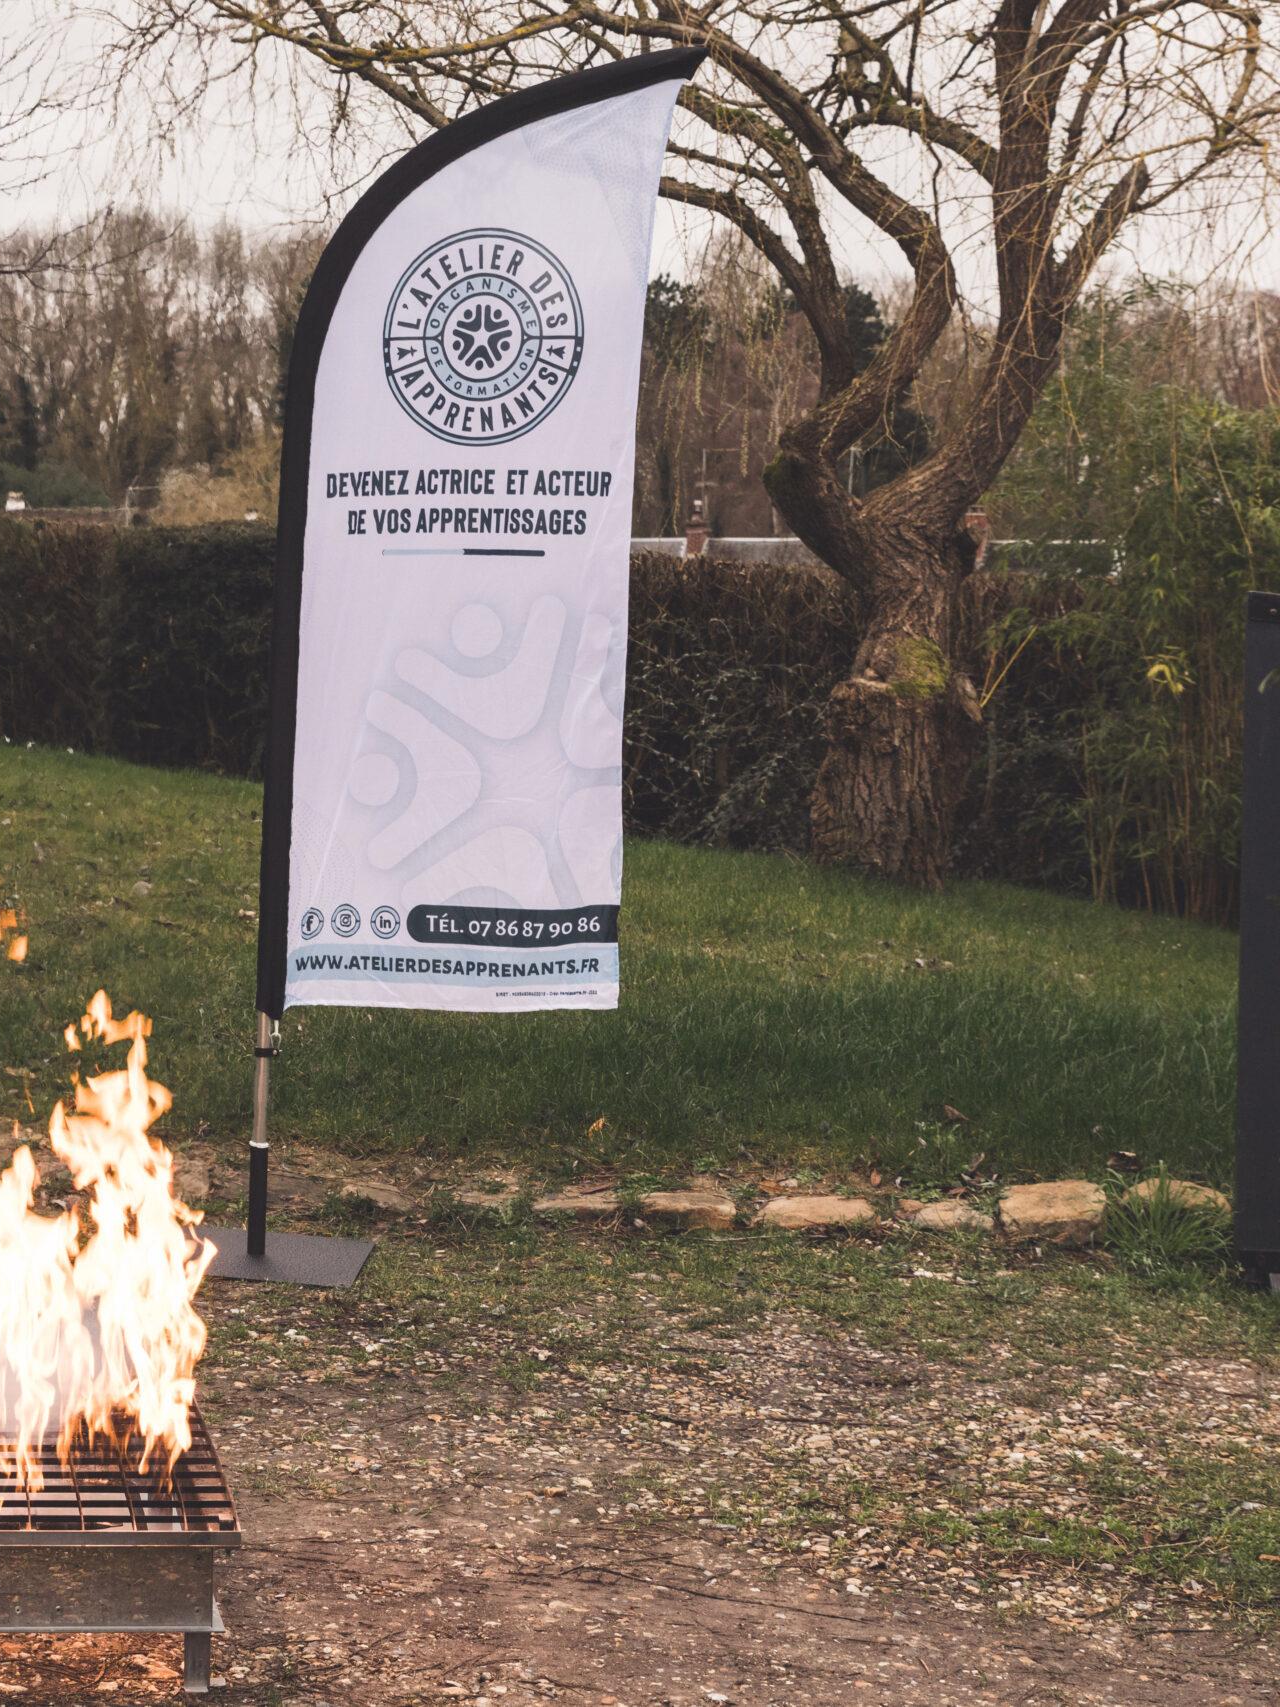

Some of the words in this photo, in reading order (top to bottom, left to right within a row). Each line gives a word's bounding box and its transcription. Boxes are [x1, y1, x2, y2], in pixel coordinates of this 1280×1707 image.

[397, 244, 524, 329] L'ATELIER
[529, 271, 568, 329] DES
[430, 279, 537, 329] ORGANISME
[430, 346, 444, 368] DE
[445, 348, 534, 395] FORMATION
[400, 366, 559, 432] APPRENANTS
[326, 470, 409, 498] DEVENEZ
[415, 469, 495, 495] ACTRICE
[506, 470, 528, 495] ET
[533, 470, 612, 497] ACTEUR
[348, 509, 366, 535] DE
[373, 509, 411, 534] VOS
[415, 508, 587, 535] APPRENTISSAGES
[426, 913, 464, 933] TÉL.
[468, 920, 491, 937] 07
[495, 919, 519, 936] 86
[522, 920, 544, 939] 87
[548, 922, 572, 938] 90
[577, 916, 601, 932] 86
[295, 955, 600, 978] WWW.ATELIERDESAPPRENANTS.FR
